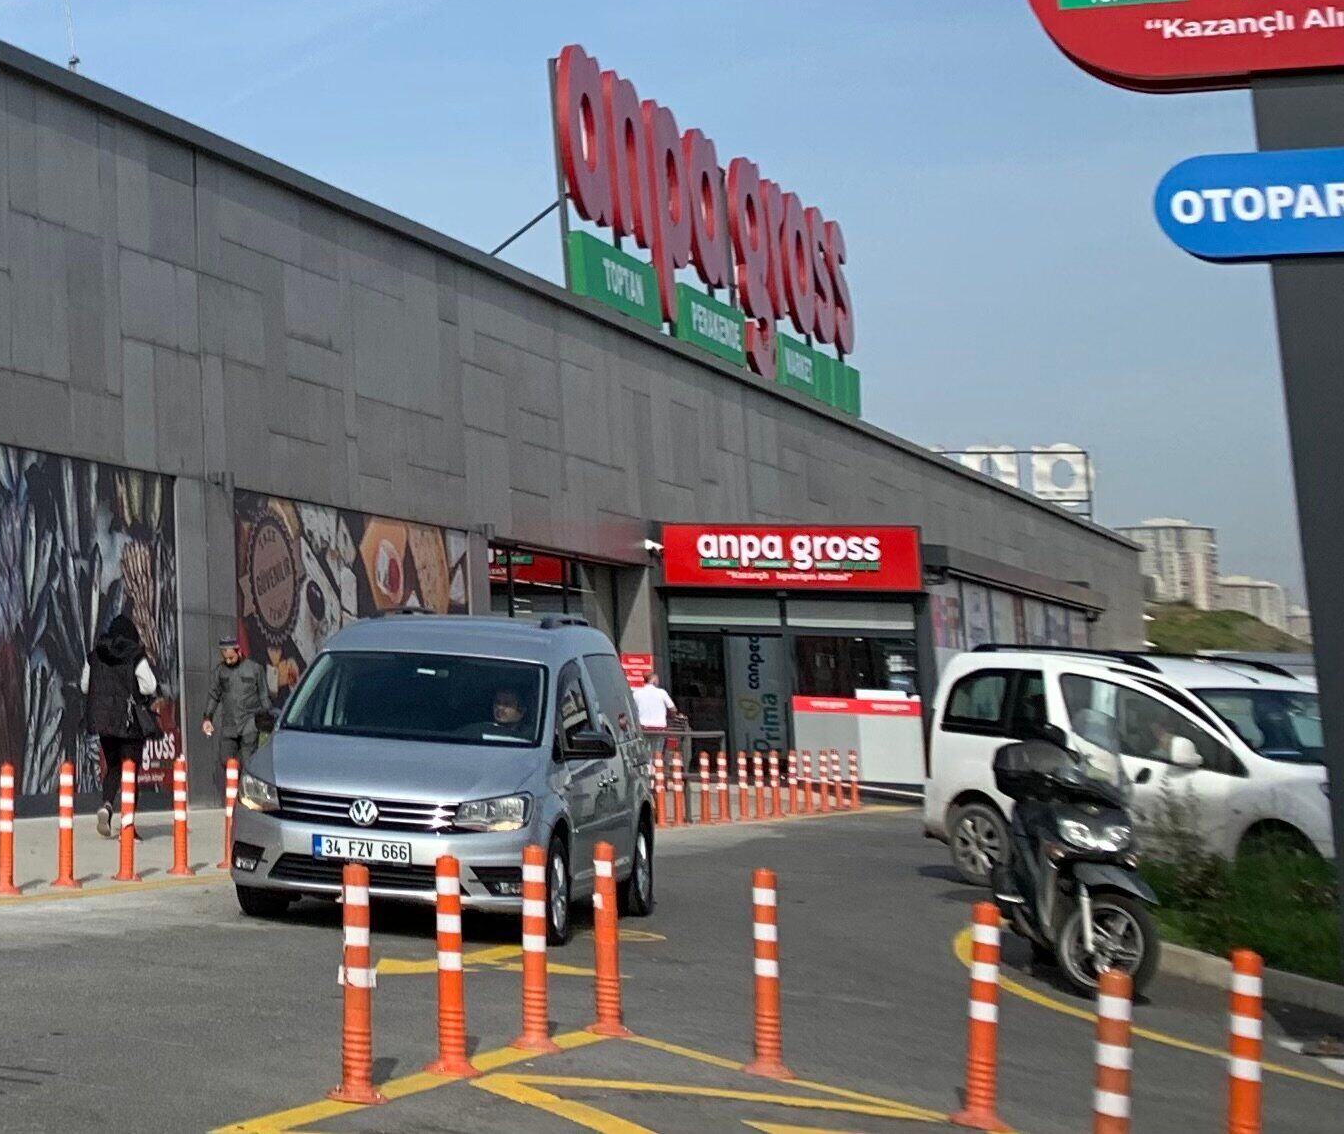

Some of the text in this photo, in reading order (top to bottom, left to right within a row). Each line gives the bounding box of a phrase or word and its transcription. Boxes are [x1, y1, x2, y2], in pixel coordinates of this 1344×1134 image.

[1144, 9, 1295, 39] “Kazançlı
[556, 44, 855, 379] anpa gross
[1170, 181, 1344, 225] OTOPAR
[602, 257, 645, 307] TOPTAN
[690, 300, 743, 353] PERAKENDE
[697, 533, 881, 570] anpa gross
[325, 839, 408, 861] 34 FZV 666
